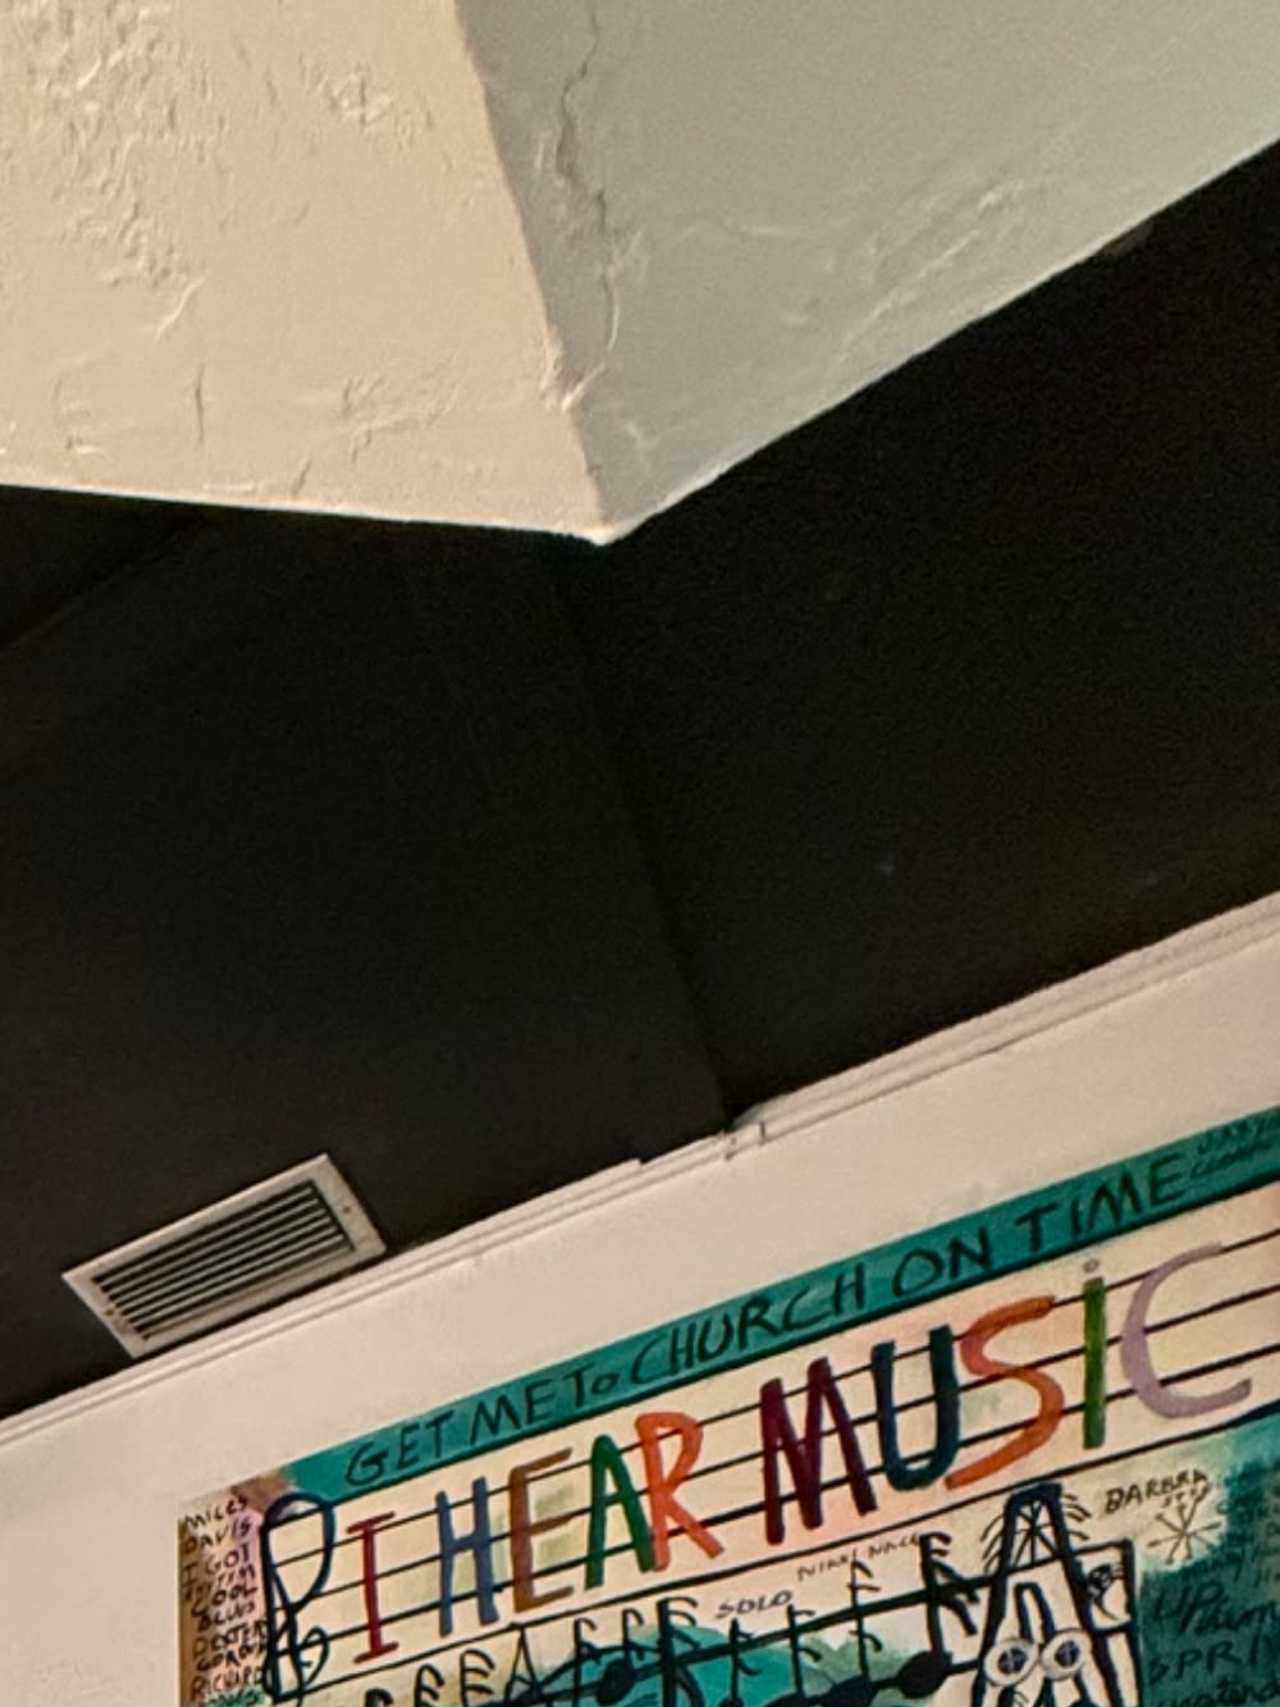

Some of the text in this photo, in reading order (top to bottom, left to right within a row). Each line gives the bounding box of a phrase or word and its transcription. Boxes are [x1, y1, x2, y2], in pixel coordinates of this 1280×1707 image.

[346, 1412, 452, 1486] GET
[470, 1374, 564, 1450] ME
[631, 1264, 864, 1389] CHURCH
[894, 1227, 988, 1296] ON
[1017, 1155, 1184, 1252] TIME
[346, 1511, 400, 1664] I
[437, 1410, 725, 1637] HEAR
[715, 1590, 793, 1619] SOLO
